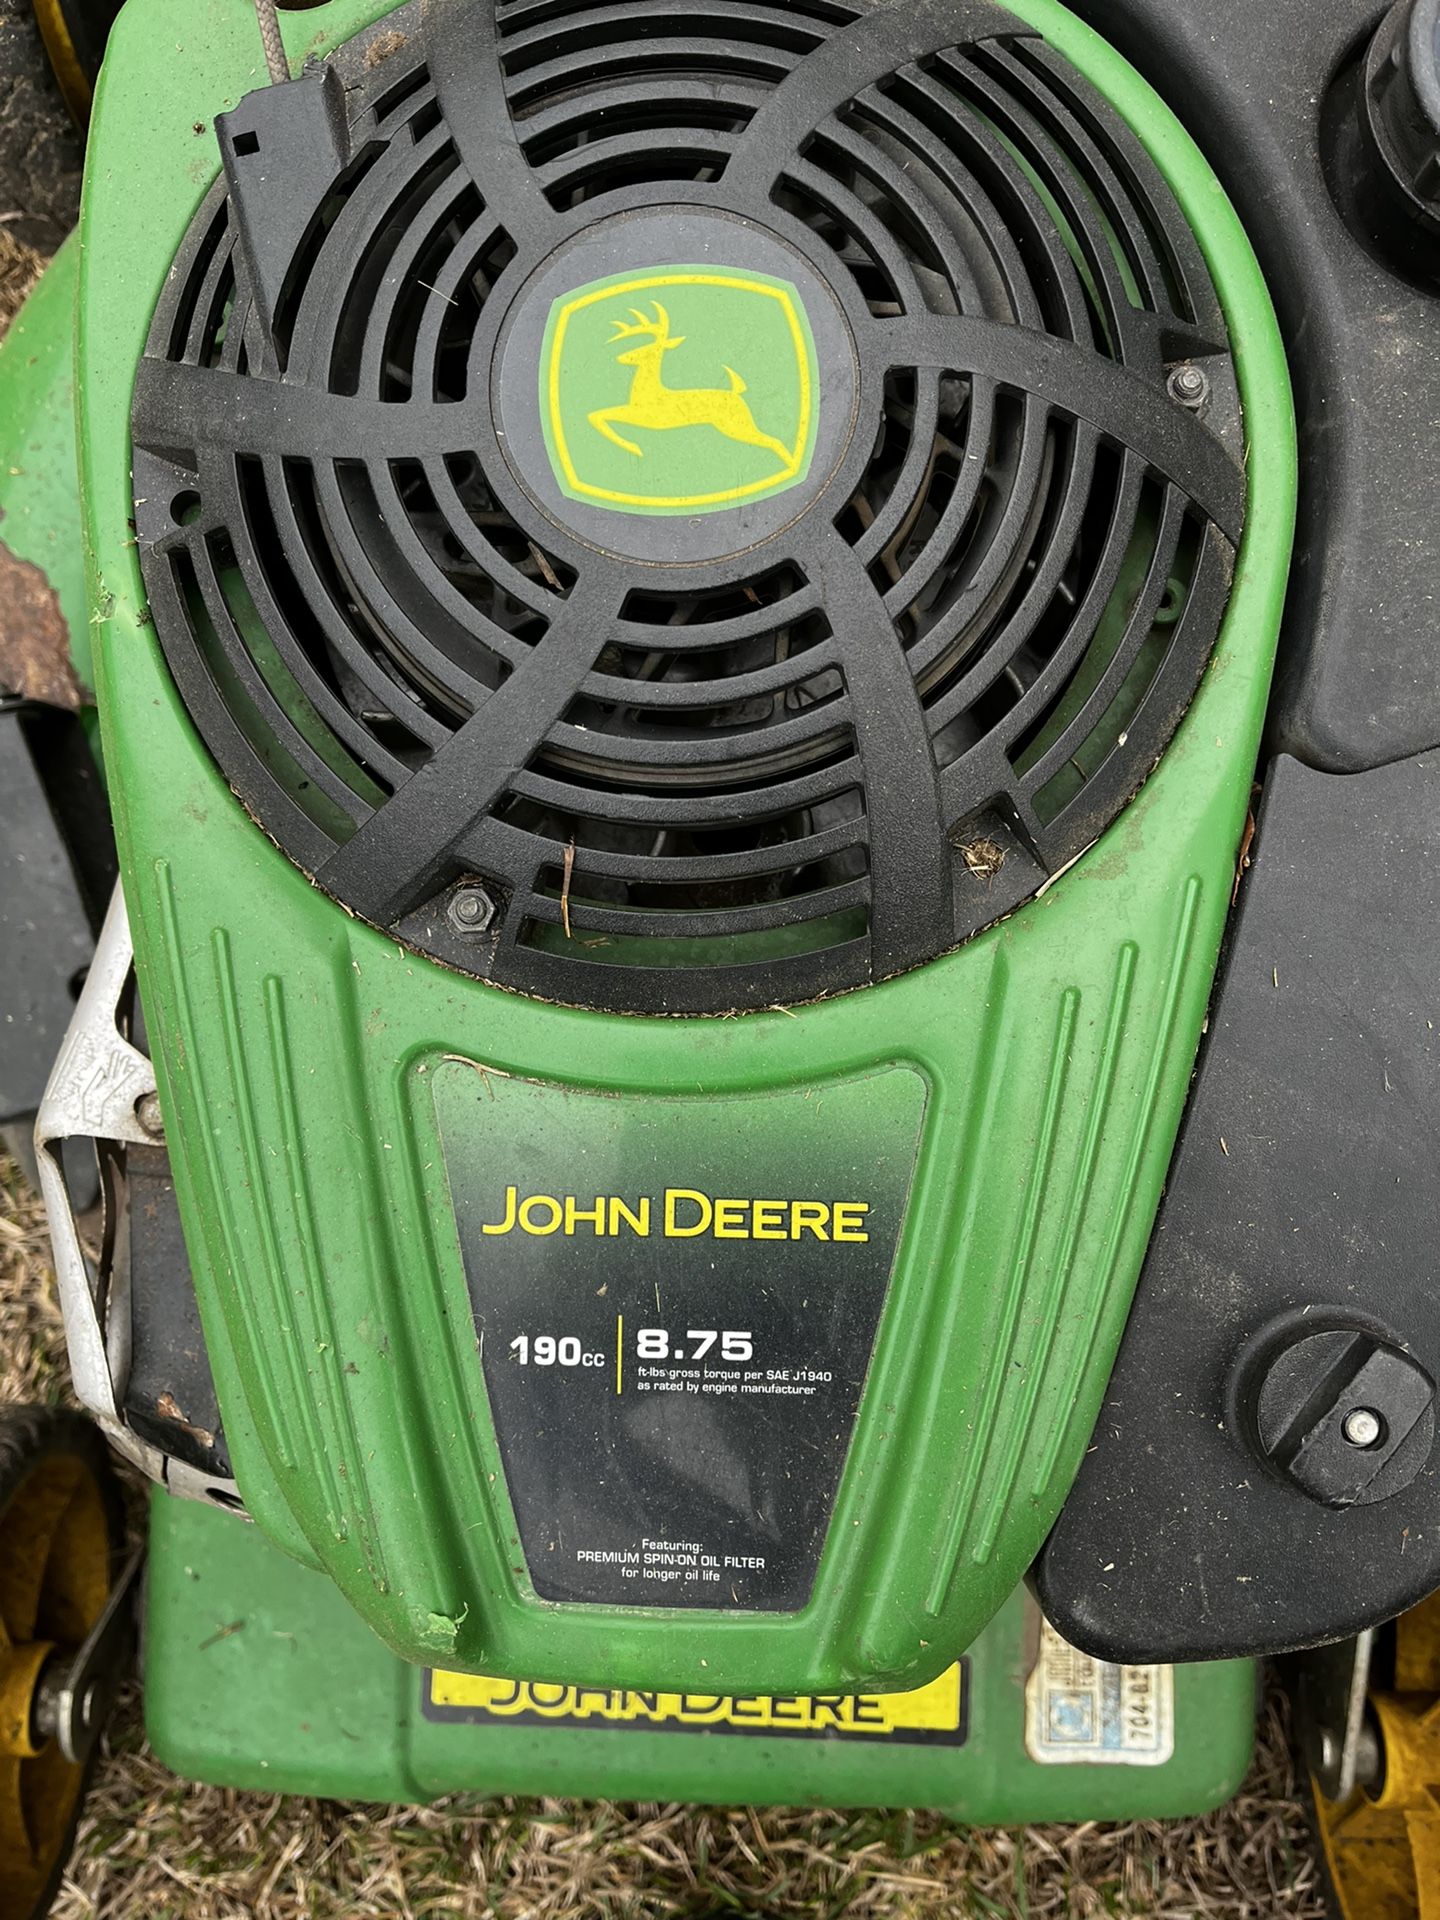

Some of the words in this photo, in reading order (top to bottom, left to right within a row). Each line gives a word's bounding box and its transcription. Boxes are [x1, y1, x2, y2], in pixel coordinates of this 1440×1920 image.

[481, 1186, 649, 1236] JOHN
[664, 1189, 869, 1242] DEERE
[636, 1328, 754, 1361] 8.75
[638, 1366, 665, 1378] ft-lbs
[669, 1369, 700, 1380] gross
[704, 1369, 741, 1380] torque
[744, 1372, 763, 1381] per
[766, 1370, 789, 1381] SAE
[793, 1371, 832, 1382] J1940
[637, 1382, 650, 1390] as
[653, 1381, 683, 1391] rated
[687, 1382, 699, 1394] by
[702, 1384, 737, 1394] engine
[741, 1383, 816, 1395] manufacturer
[642, 1538, 704, 1554] Featuring:
[577, 1551, 640, 1564] PREMIUM
[643, 1554, 697, 1567] SPIN-ON
[701, 1555, 721, 1568] OIL
[724, 1556, 766, 1569] FILTER
[621, 1567, 639, 1579] for
[643, 1568, 681, 1582] longer
[685, 1569, 699, 1581] oil
[703, 1570, 721, 1582] life
